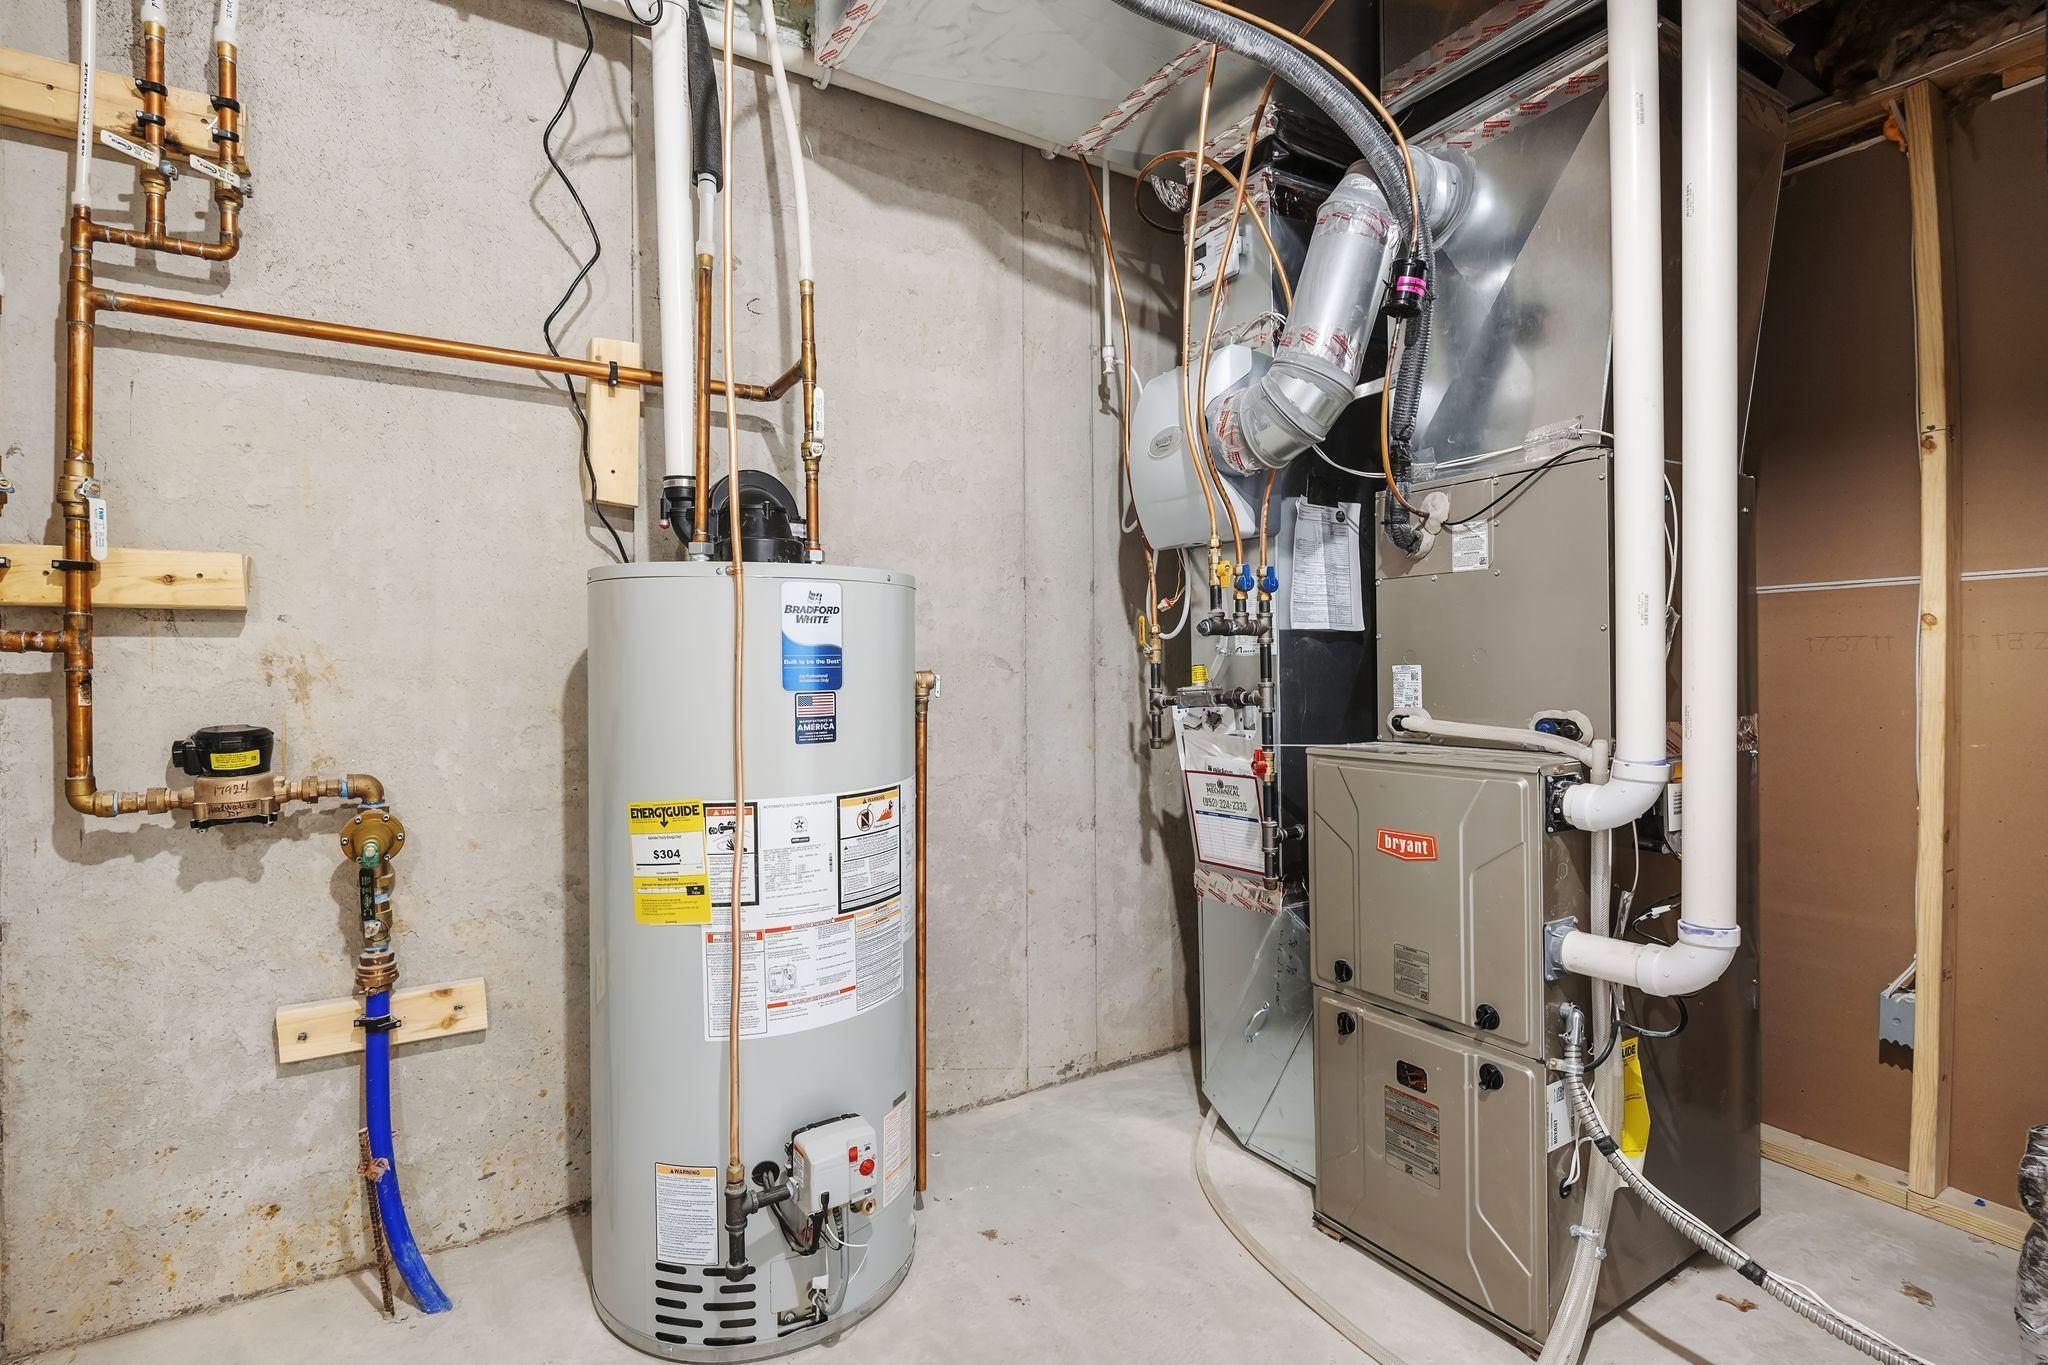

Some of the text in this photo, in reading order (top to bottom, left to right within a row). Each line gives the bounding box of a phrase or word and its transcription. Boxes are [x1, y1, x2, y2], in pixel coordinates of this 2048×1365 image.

[784, 605, 840, 615] BRADFORD
[795, 615, 829, 624] WHITE
[797, 722, 835, 732] AMERICA
[213, 780, 250, 796] 17924
[1206, 787, 1240, 797] MECHANICAL
[1384, 834, 1428, 855] bryant
[653, 849, 681, 860] $304
[674, 1168, 701, 1176] WARNING
